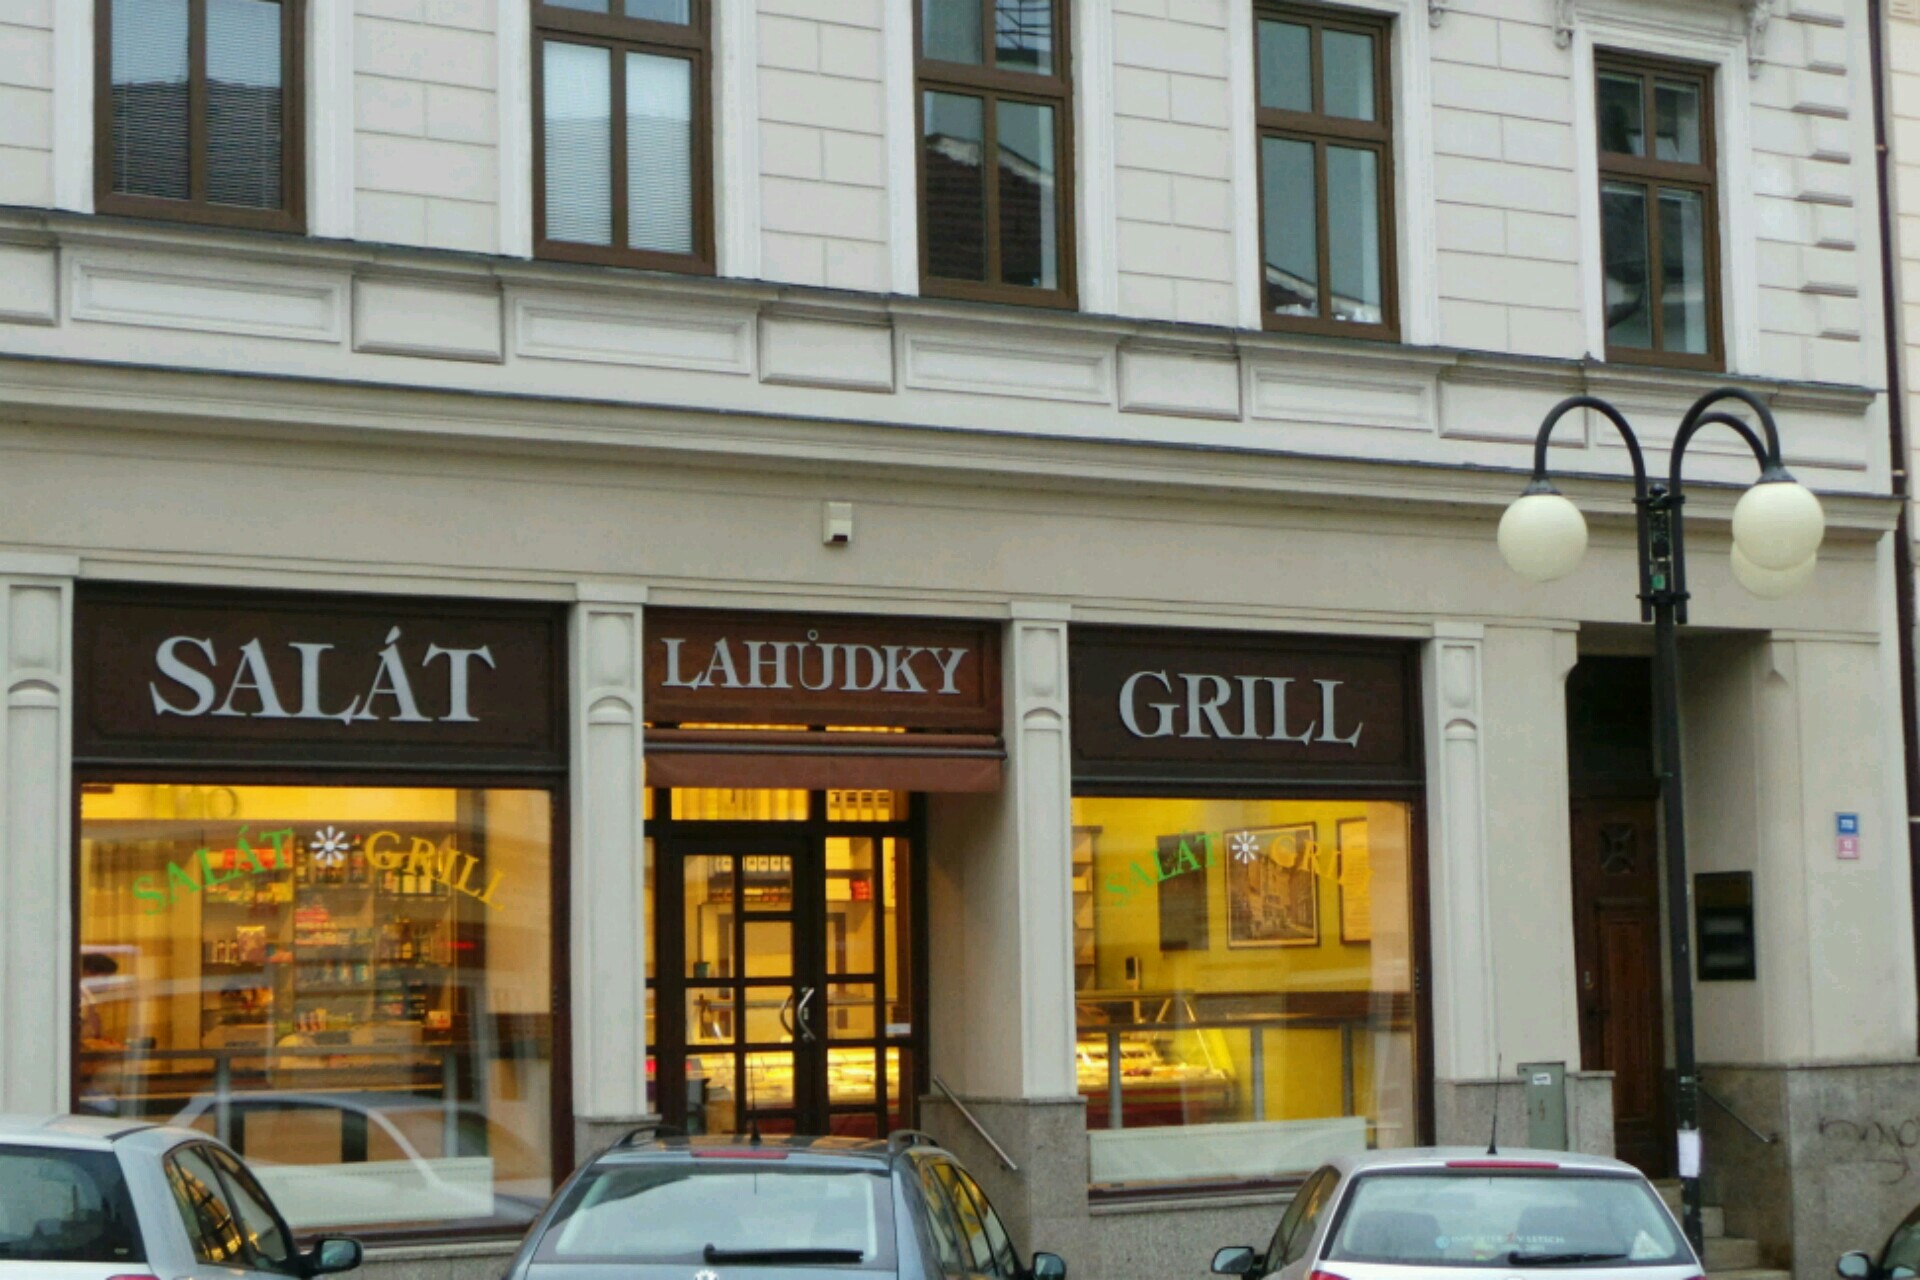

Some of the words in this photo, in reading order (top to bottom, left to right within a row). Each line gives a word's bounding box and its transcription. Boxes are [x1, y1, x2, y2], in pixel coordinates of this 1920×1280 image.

[149, 626, 496, 726] SALÁT
[660, 629, 969, 695] LAHŮDKY
[1119, 669, 1363, 748] GRILL
[132, 825, 294, 916] SALÁT
[364, 830, 506, 912] GRILL
[1104, 830, 1220, 908] SALÁT
[1269, 833, 1374, 892] GRI
